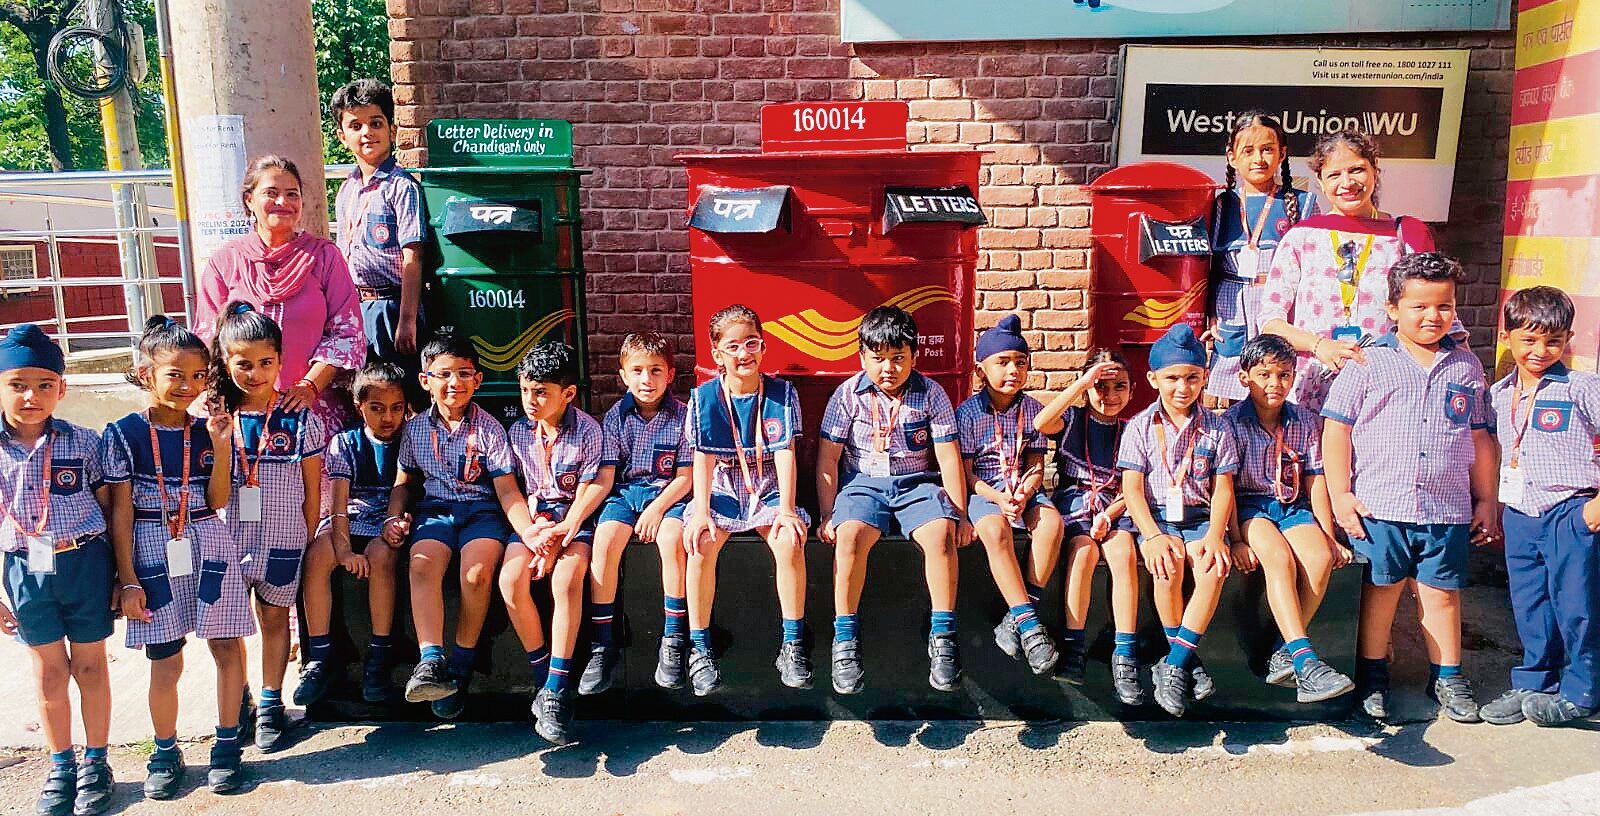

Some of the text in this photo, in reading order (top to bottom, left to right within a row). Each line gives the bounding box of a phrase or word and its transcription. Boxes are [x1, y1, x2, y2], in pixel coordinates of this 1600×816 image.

[1312, 59, 1328, 68] Call
[1351, 60, 1364, 68] toll
[1365, 60, 1381, 69] free
[1397, 61, 1415, 69] 1800
[1417, 61, 1436, 69] 1027
[1437, 61, 1452, 69] 111
[1312, 71, 1330, 80] Visit
[1340, 72, 1350, 80] at
[1351, 72, 1444, 82] westernunion.com/india
[792, 106, 867, 133] 160014
[437, 122, 554, 142] Letter Delivery in
[452, 139, 546, 155] Chandigarh Only
[712, 198, 762, 222] पत्र
[897, 194, 979, 214] LETTERS
[469, 205, 518, 225] पत्र
[218, 227, 250, 236] SERIES
[230, 219, 252, 228] 2024
[1165, 225, 1194, 239] पत्र
[1154, 238, 1210, 254] LETTERS
[467, 288, 527, 309] 160014
[928, 334, 945, 346] डाक
[924, 347, 945, 357] Post
